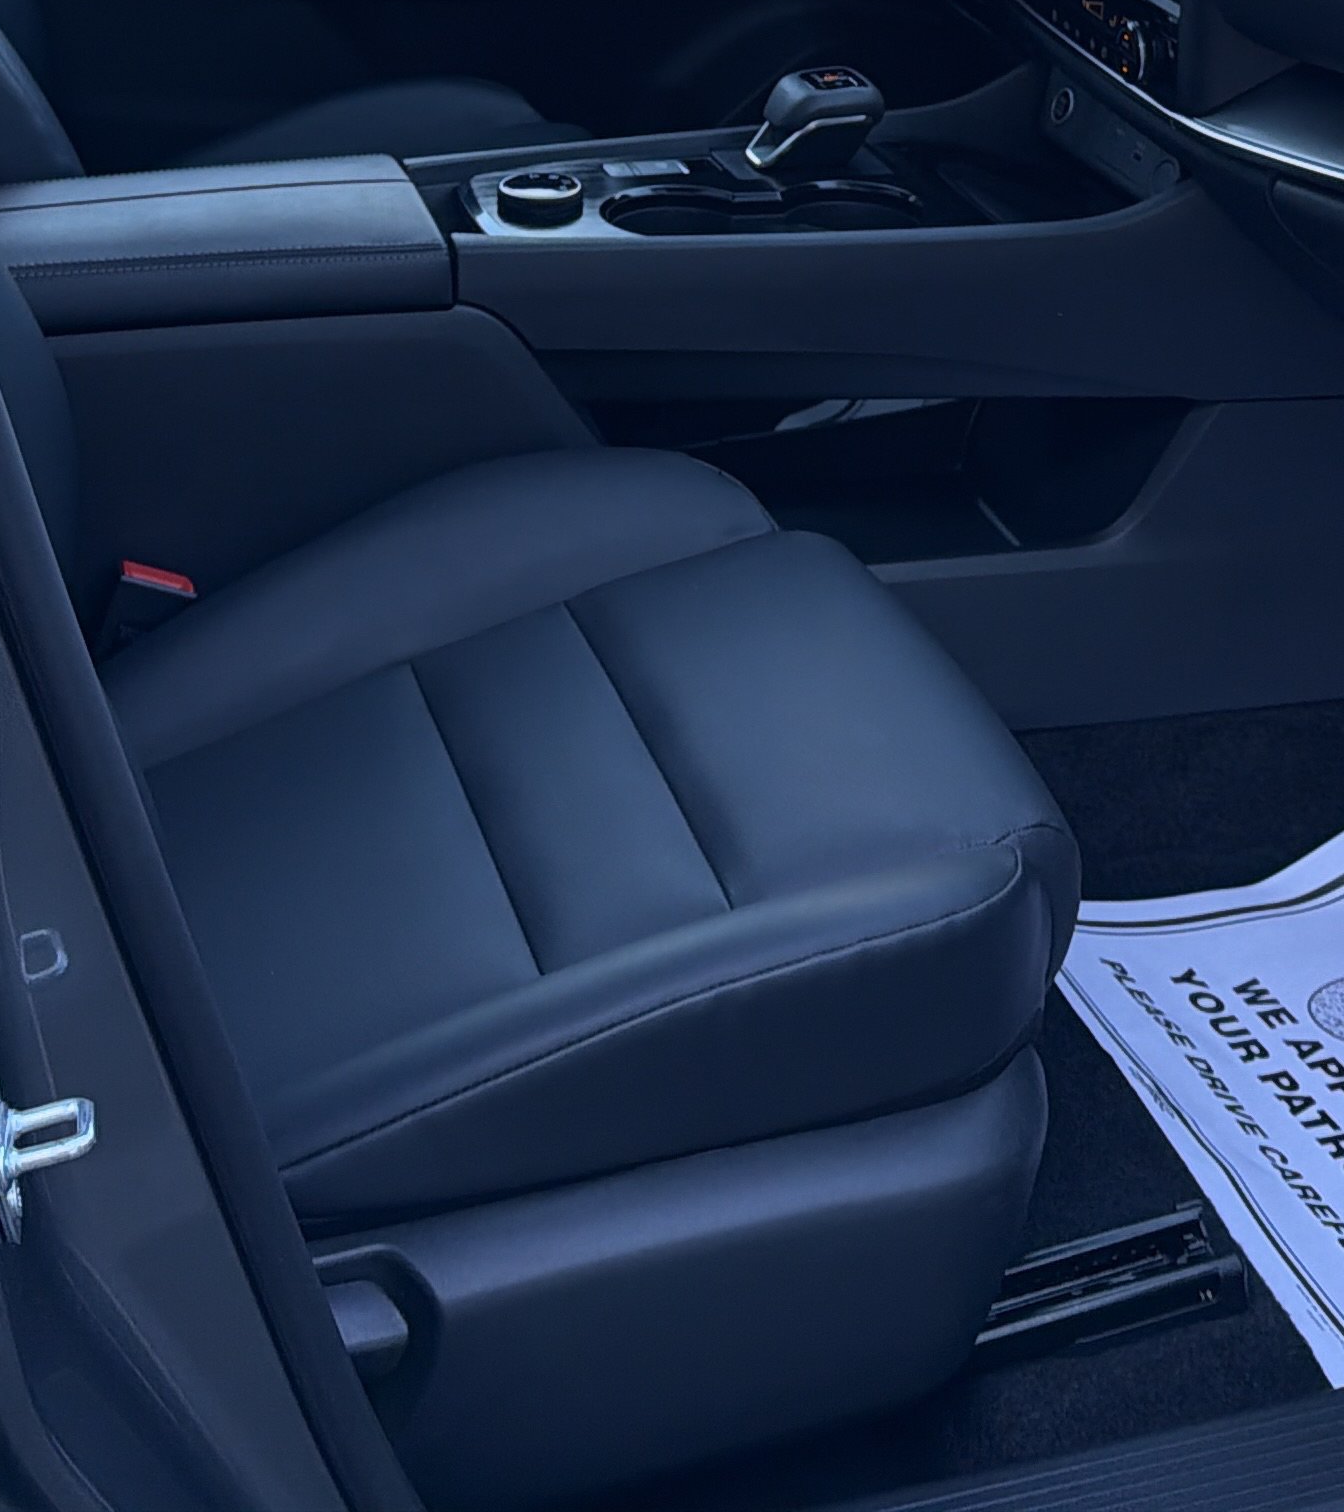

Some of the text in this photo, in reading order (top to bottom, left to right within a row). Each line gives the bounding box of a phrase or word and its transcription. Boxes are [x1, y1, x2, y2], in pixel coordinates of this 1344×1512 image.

[1099, 957, 1197, 1050] PLEASE
[1184, 1054, 1269, 1140] DRIVE
[1171, 968, 1270, 1063] YOUR
[1232, 977, 1299, 1029] WE
